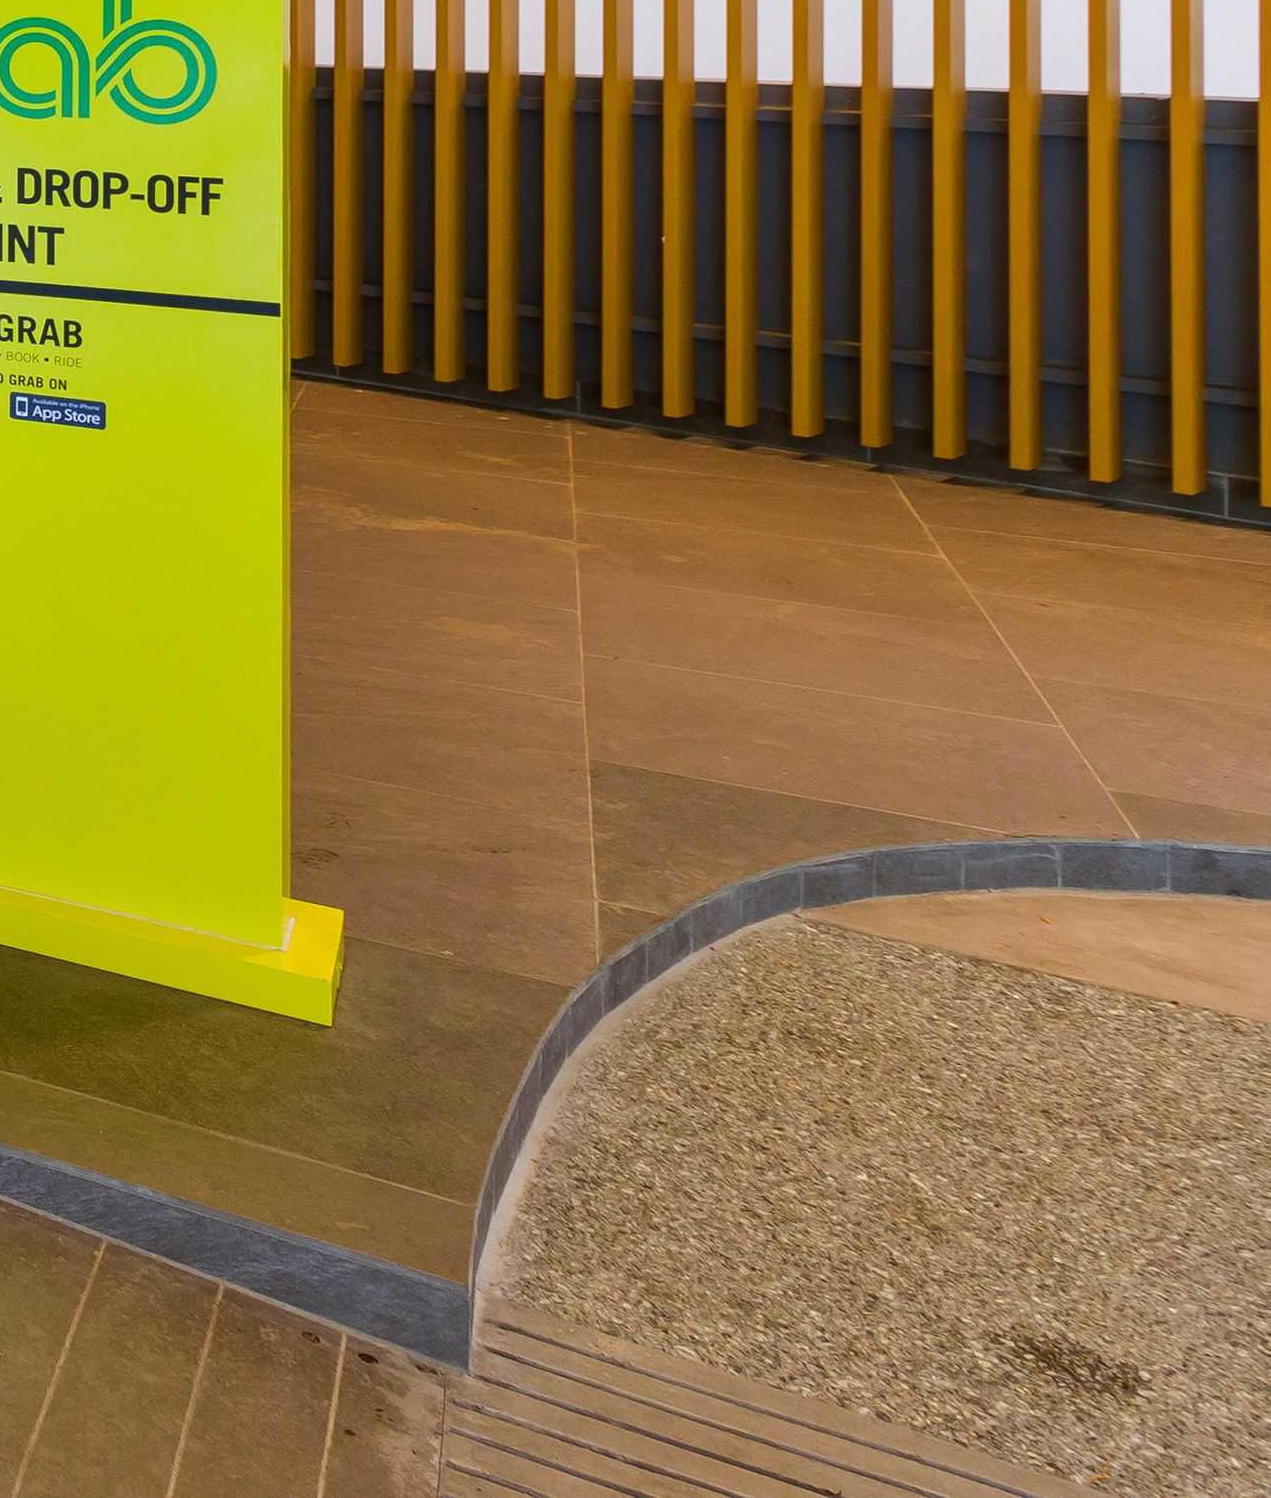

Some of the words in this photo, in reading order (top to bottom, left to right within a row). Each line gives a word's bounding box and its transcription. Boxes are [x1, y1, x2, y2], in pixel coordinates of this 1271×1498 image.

[16, 167, 224, 216] DROP-OFF
[5, 352, 40, 364] BOOK
[54, 355, 83, 368] RIDE
[8, 374, 44, 389] GRAB
[49, 378, 68, 391] ON
[32, 405, 62, 422] App
[64, 409, 101, 425] Store
